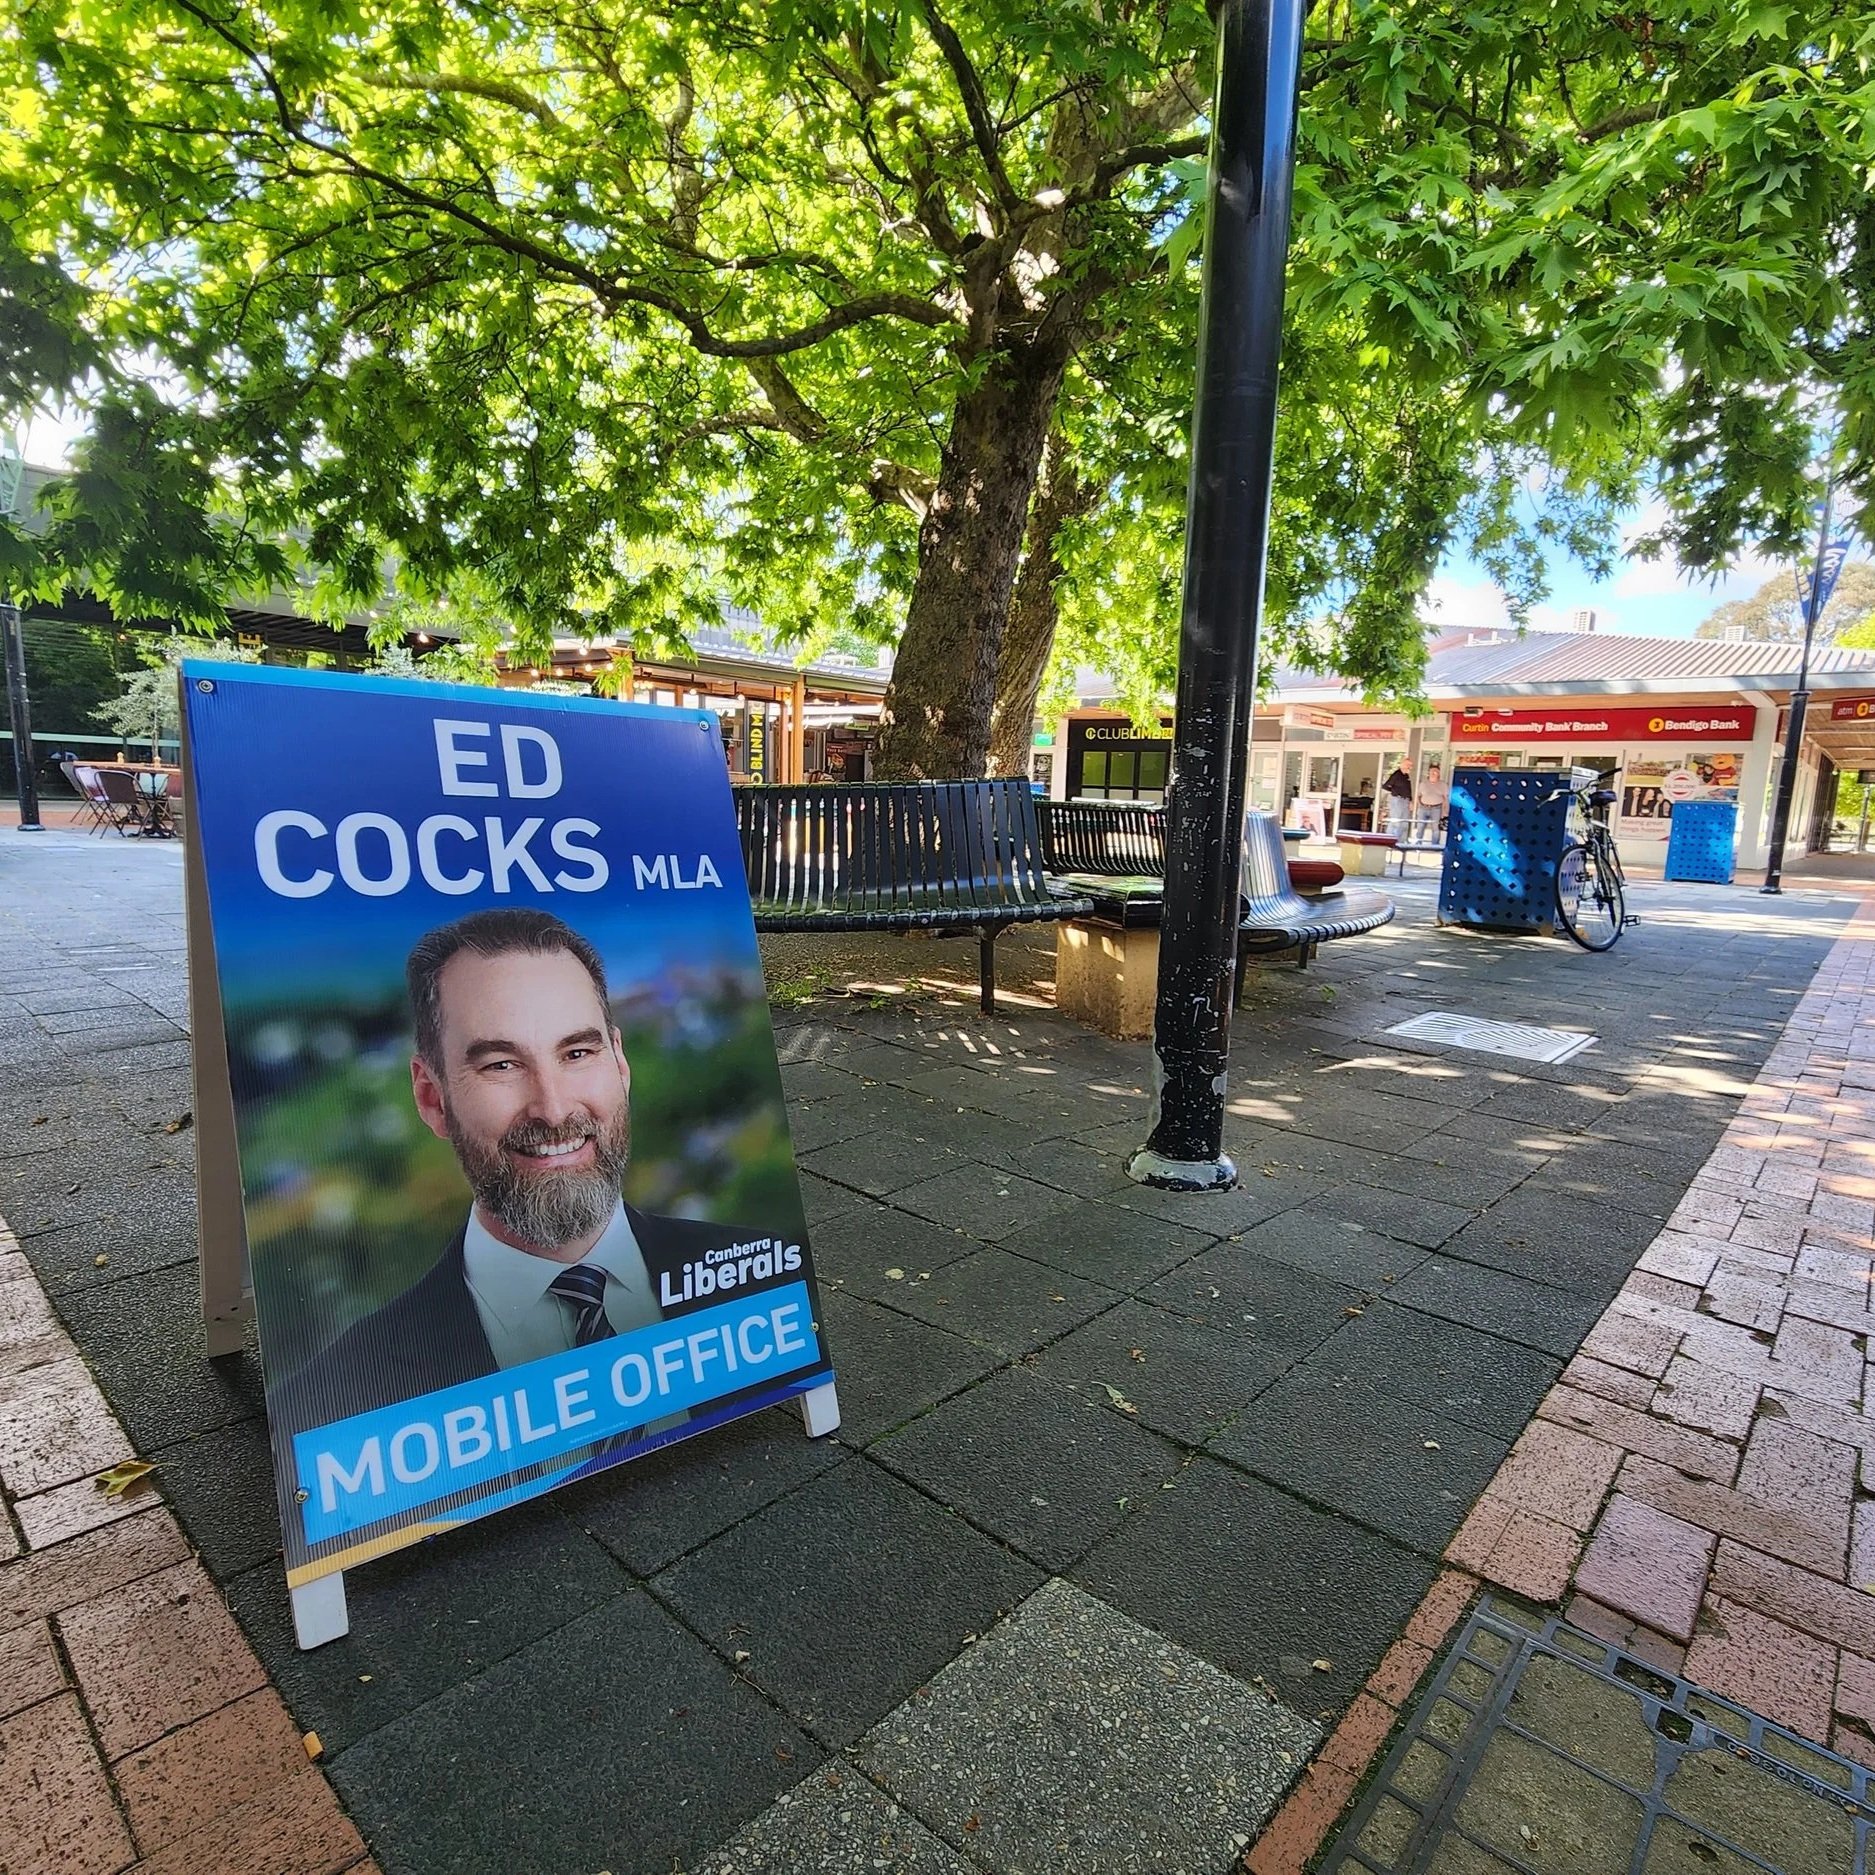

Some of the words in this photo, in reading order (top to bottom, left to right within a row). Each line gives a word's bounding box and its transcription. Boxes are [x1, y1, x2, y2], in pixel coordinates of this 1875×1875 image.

[1462, 723, 1489, 733] Curtin
[1491, 722, 1544, 733] Community
[1572, 721, 1608, 732] Branch
[1664, 720, 1709, 731] Bendigo
[1710, 719, 1740, 730] Bank
[1837, 706, 1853, 716] atm
[432, 718, 563, 799] ED
[751, 728, 763, 769] BLIND
[254, 809, 610, 898] COCKS
[632, 854, 724, 890] MLA
[705, 1238, 771, 1265] Canberra
[660, 1240, 802, 1307] Liberals
[316, 1368, 597, 1514] MOBILE
[610, 1303, 807, 1408] OFFICE
